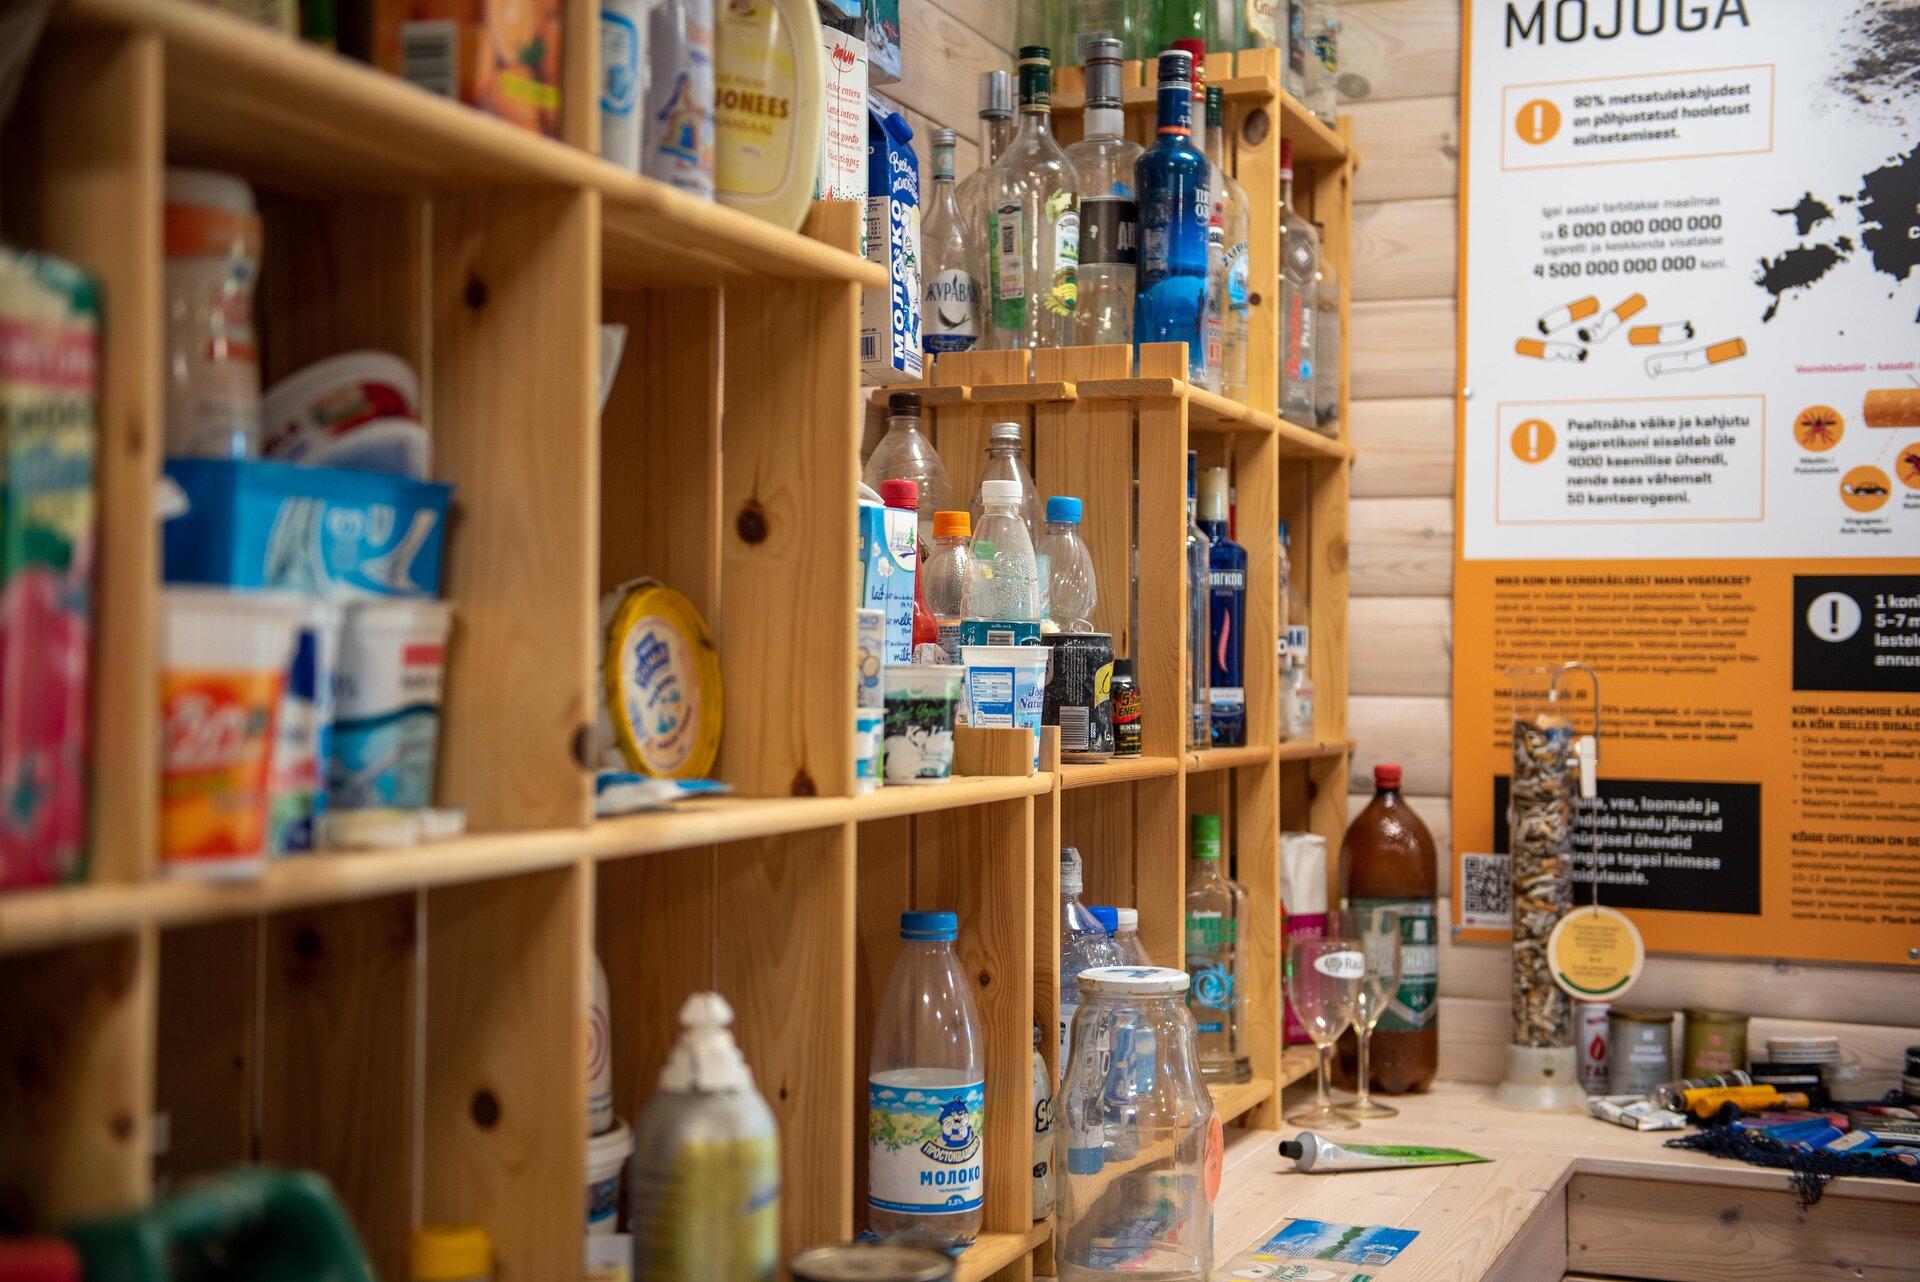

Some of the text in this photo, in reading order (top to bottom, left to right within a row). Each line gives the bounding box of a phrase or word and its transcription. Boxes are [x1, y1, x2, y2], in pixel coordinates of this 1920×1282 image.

[1573, 221, 1606, 238] 000
[1611, 218, 1644, 235] 000
[1648, 216, 1682, 233] 000
[1687, 214, 1722, 231] 000
[1549, 262, 1581, 278] 500
[1586, 260, 1619, 275] 000
[1624, 257, 1657, 273] 000
[1662, 255, 1696, 271] 000
[1679, 415, 1692, 432] ja
[1695, 415, 1750, 430] kahjutu
[1647, 472, 1712, 485] vähemalt
[1874, 594, 1886, 609] 1
[1874, 632, 1920, 648] lastel
[1641, 796, 1703, 812] loomade
[1704, 798, 1720, 816] ja
[1619, 813, 1664, 830] kaudu
[1665, 815, 1723, 833] jõuavad
[1634, 833, 1692, 850] ühendid
[1617, 851, 1662, 869] tagasi
[1663, 852, 1721, 870] inimese
[920, 1165, 980, 1186] МОЛОКО
